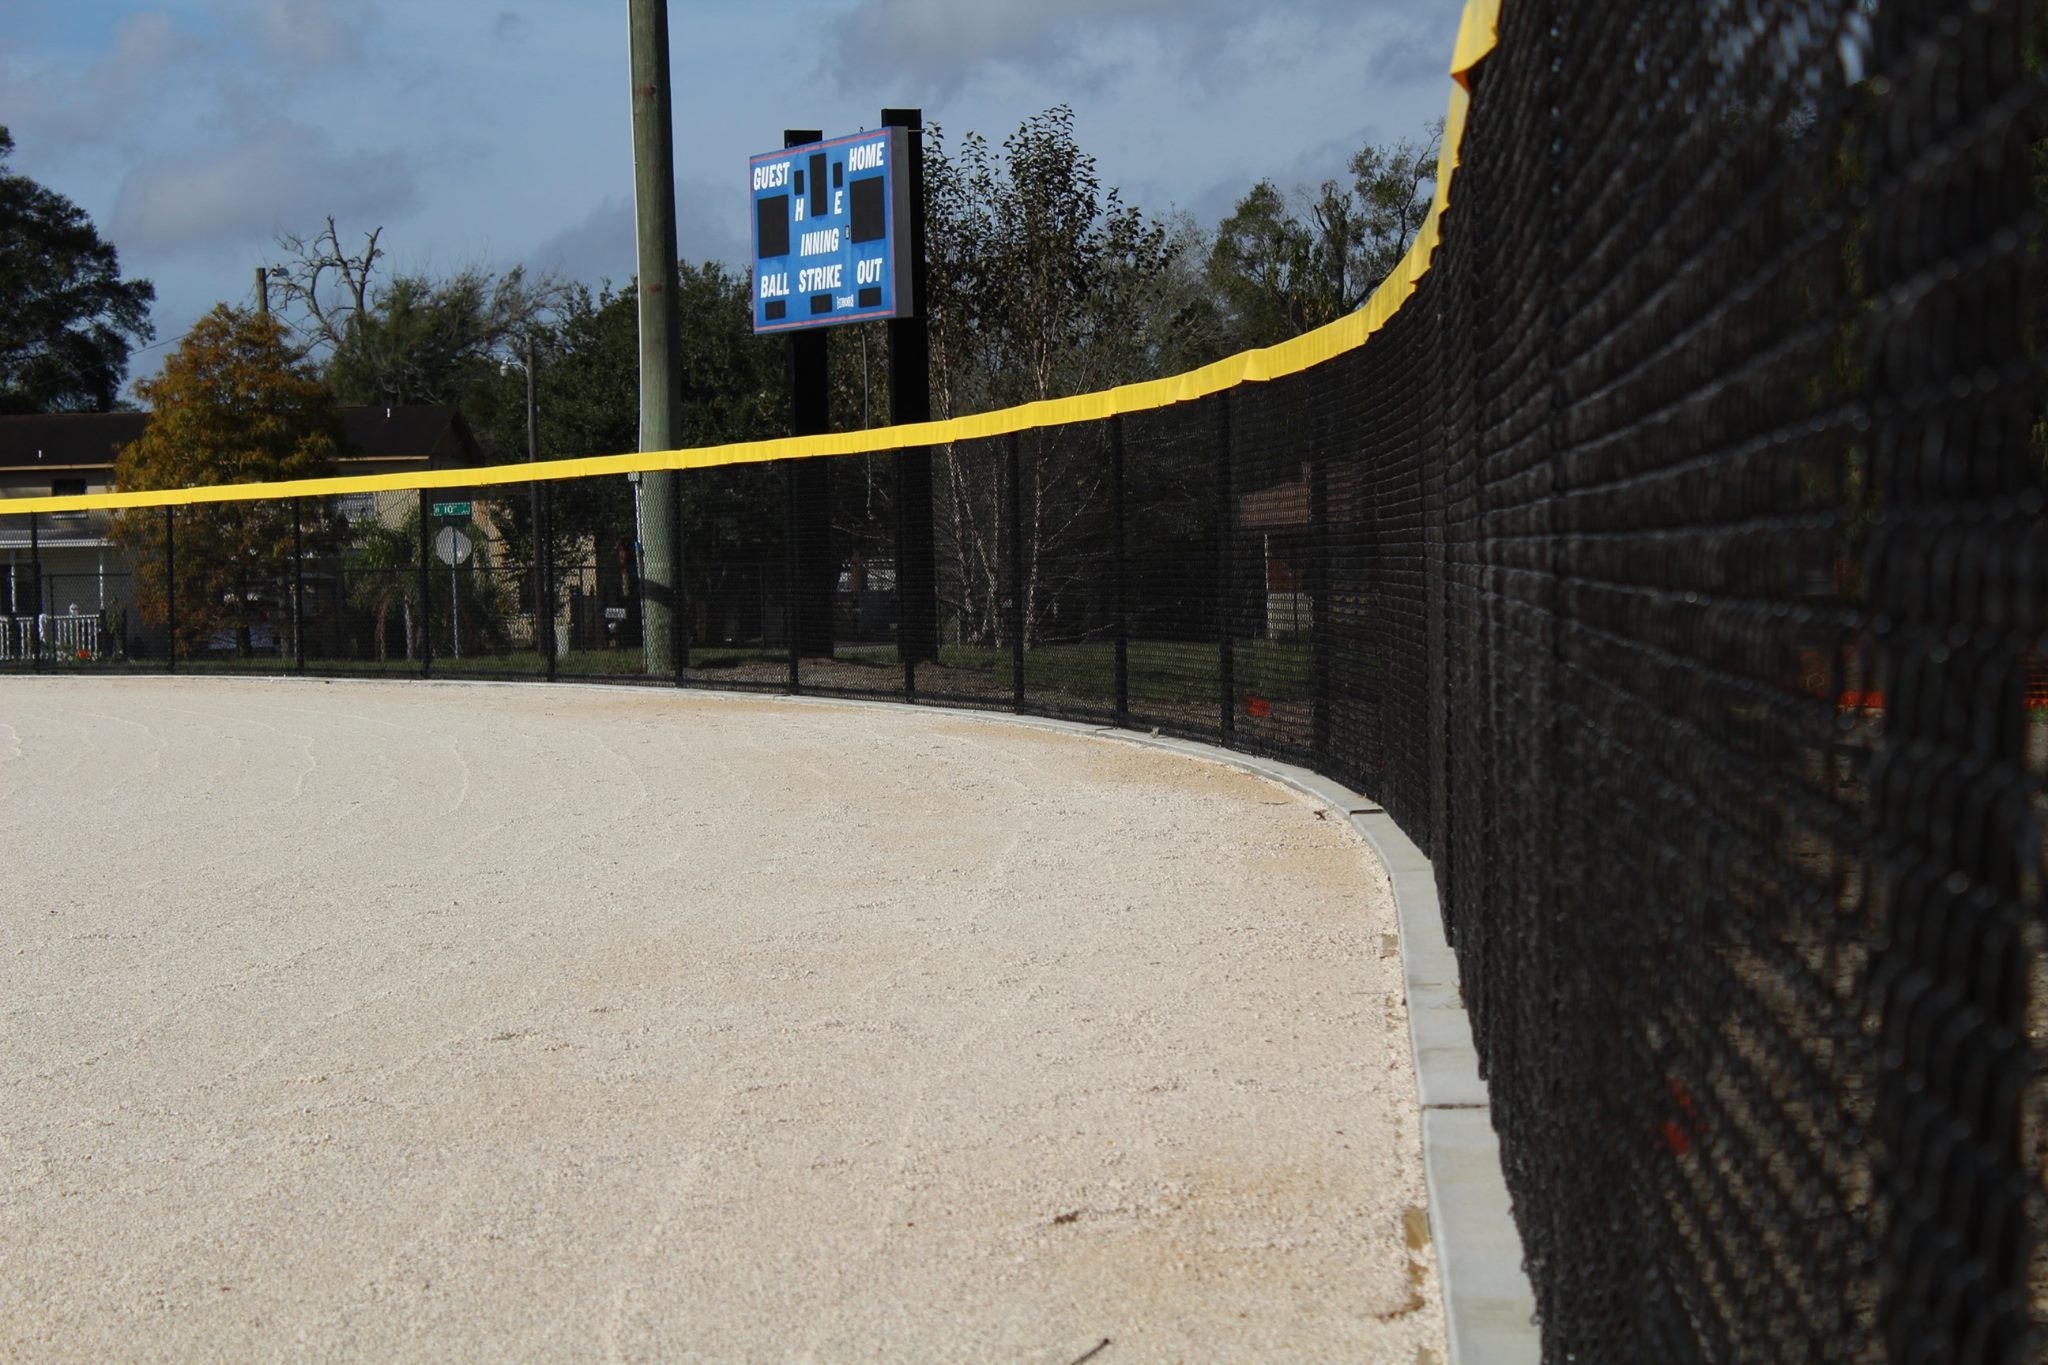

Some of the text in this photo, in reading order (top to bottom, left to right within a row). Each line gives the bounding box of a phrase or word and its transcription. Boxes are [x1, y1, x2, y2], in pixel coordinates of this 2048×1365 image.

[754, 141, 884, 190] GUEST HOME
[795, 191, 842, 221] H E
[801, 228, 839, 256] INNING
[761, 258, 882, 298] BALL STRIKE OUT
